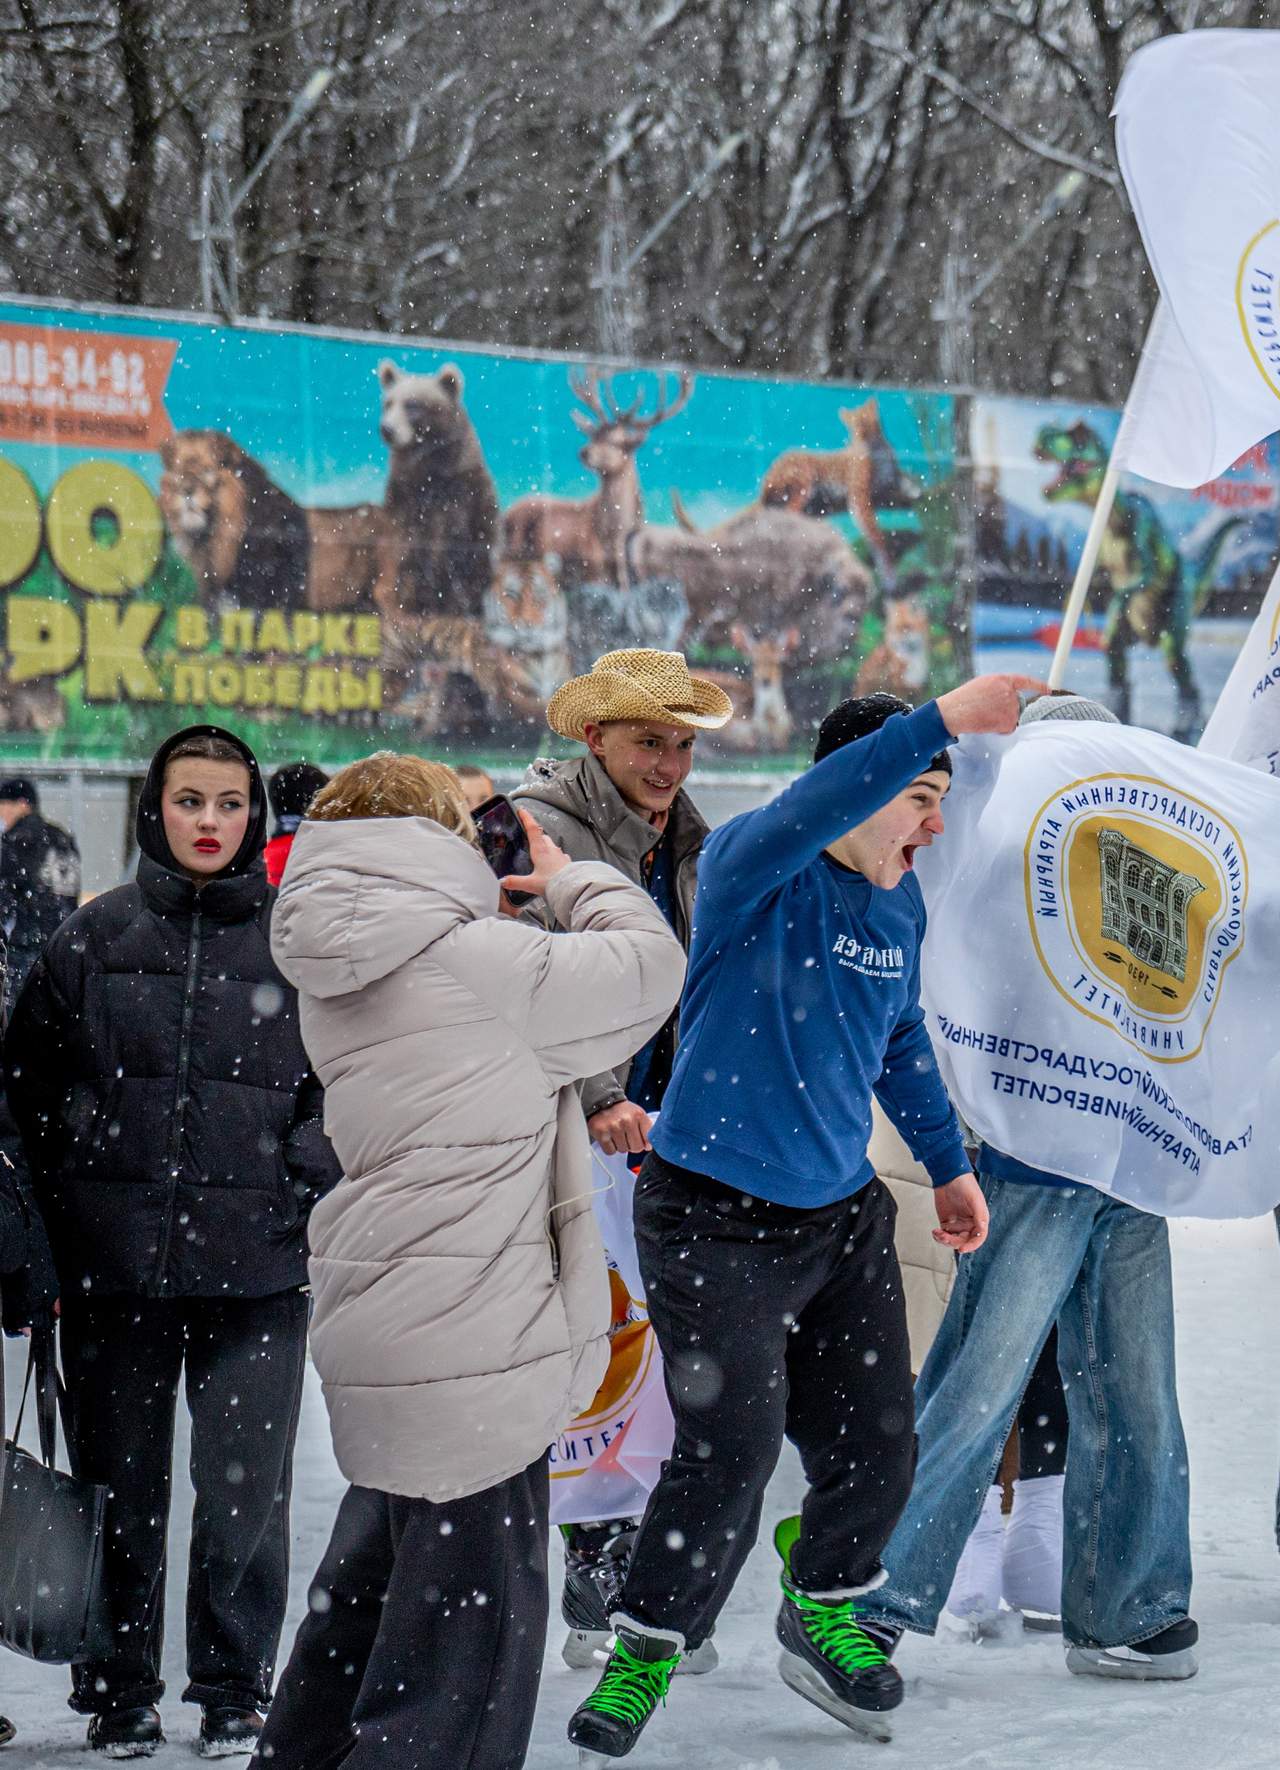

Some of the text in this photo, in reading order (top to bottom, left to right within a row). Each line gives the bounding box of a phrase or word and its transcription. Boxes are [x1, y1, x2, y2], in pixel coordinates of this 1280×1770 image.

[177, 606, 382, 656] В ПАРКЕ
[174, 662, 383, 714] ПОБЕДЫ
